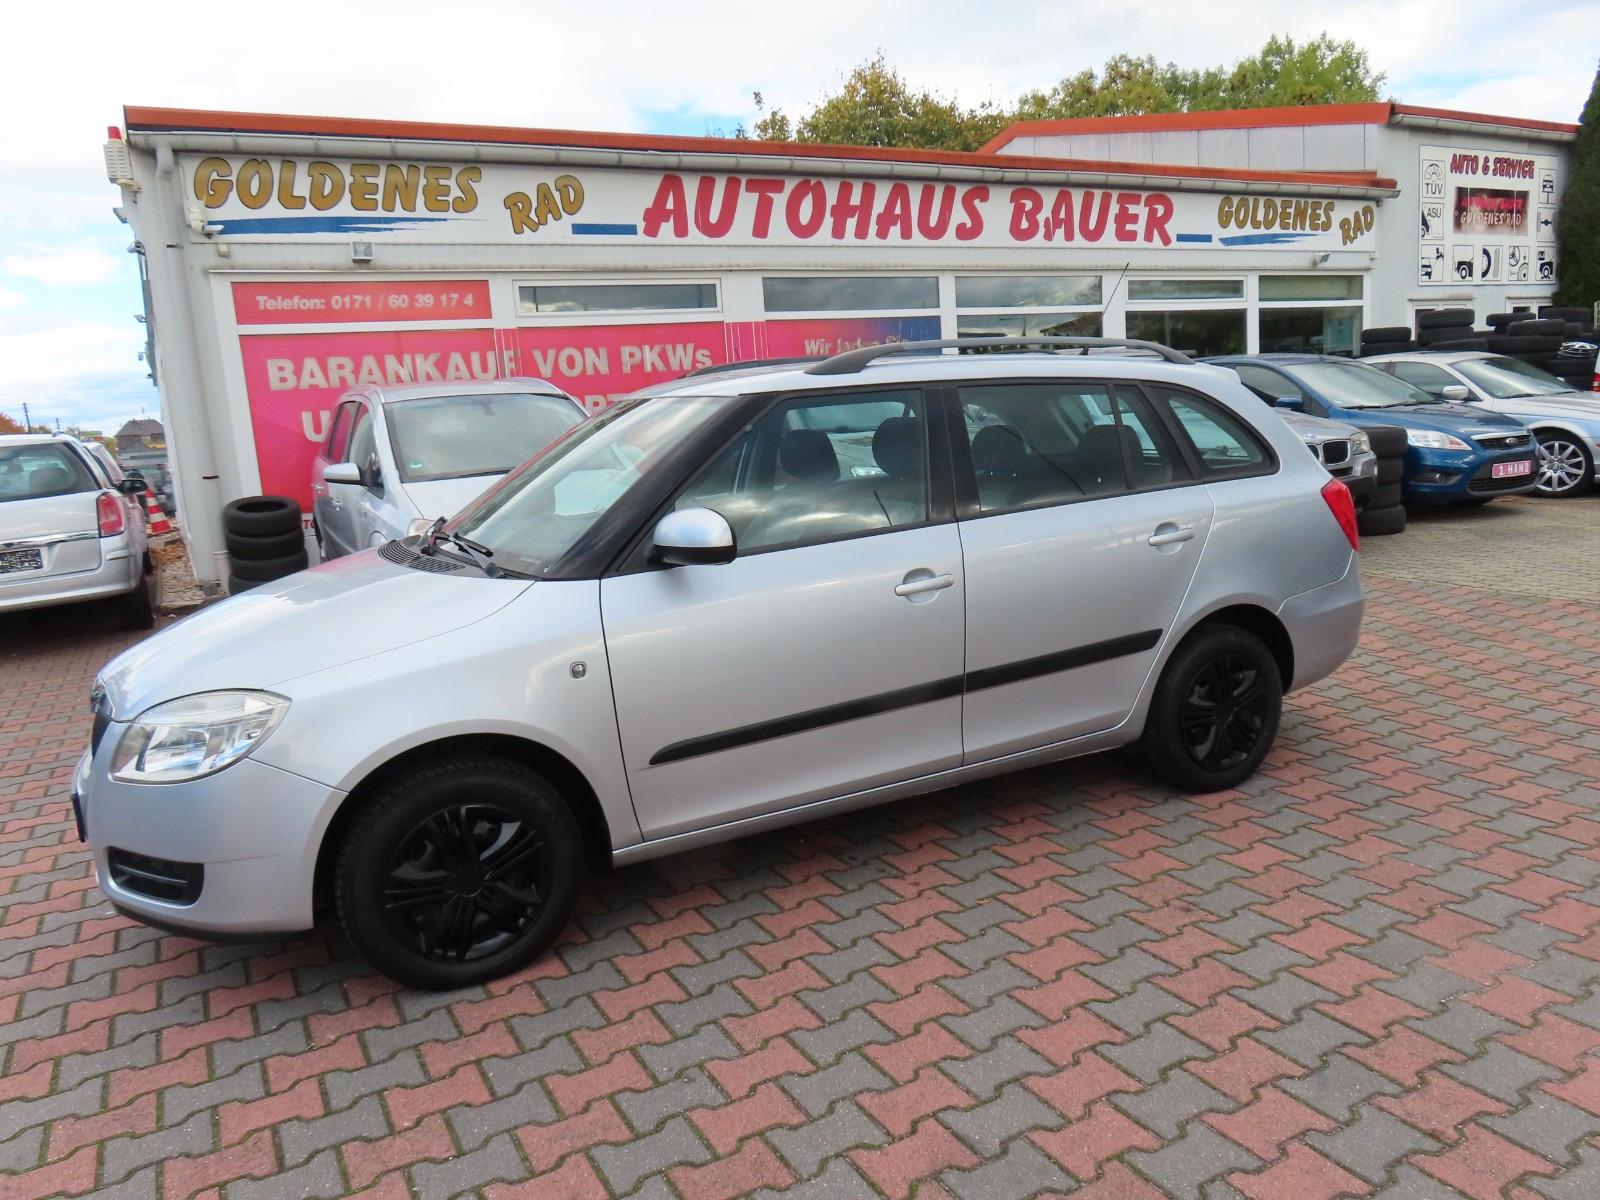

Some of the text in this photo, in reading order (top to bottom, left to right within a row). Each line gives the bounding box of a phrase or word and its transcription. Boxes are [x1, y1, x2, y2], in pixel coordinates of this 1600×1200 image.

[1450, 153, 1479, 175] AUTO
[1492, 157, 1535, 179] SERVICE
[194, 157, 585, 234] GOLDENES RAD
[1424, 180, 1443, 195] TÜV
[642, 173, 1175, 247] AUTOHAUS BAUER
[1217, 195, 1375, 246] GOLDENES RAD
[1426, 207, 1441, 218] ASU
[256, 295, 325, 311] Telefon:
[331, 294, 371, 309] 0171
[388, 294, 409, 308] 60
[414, 293, 434, 308] 39
[440, 293, 458, 307] 17
[463, 293, 475, 307] 4
[804, 338, 832, 355] Wir
[266, 343, 713, 391] BARANKAUF VON PKWs
